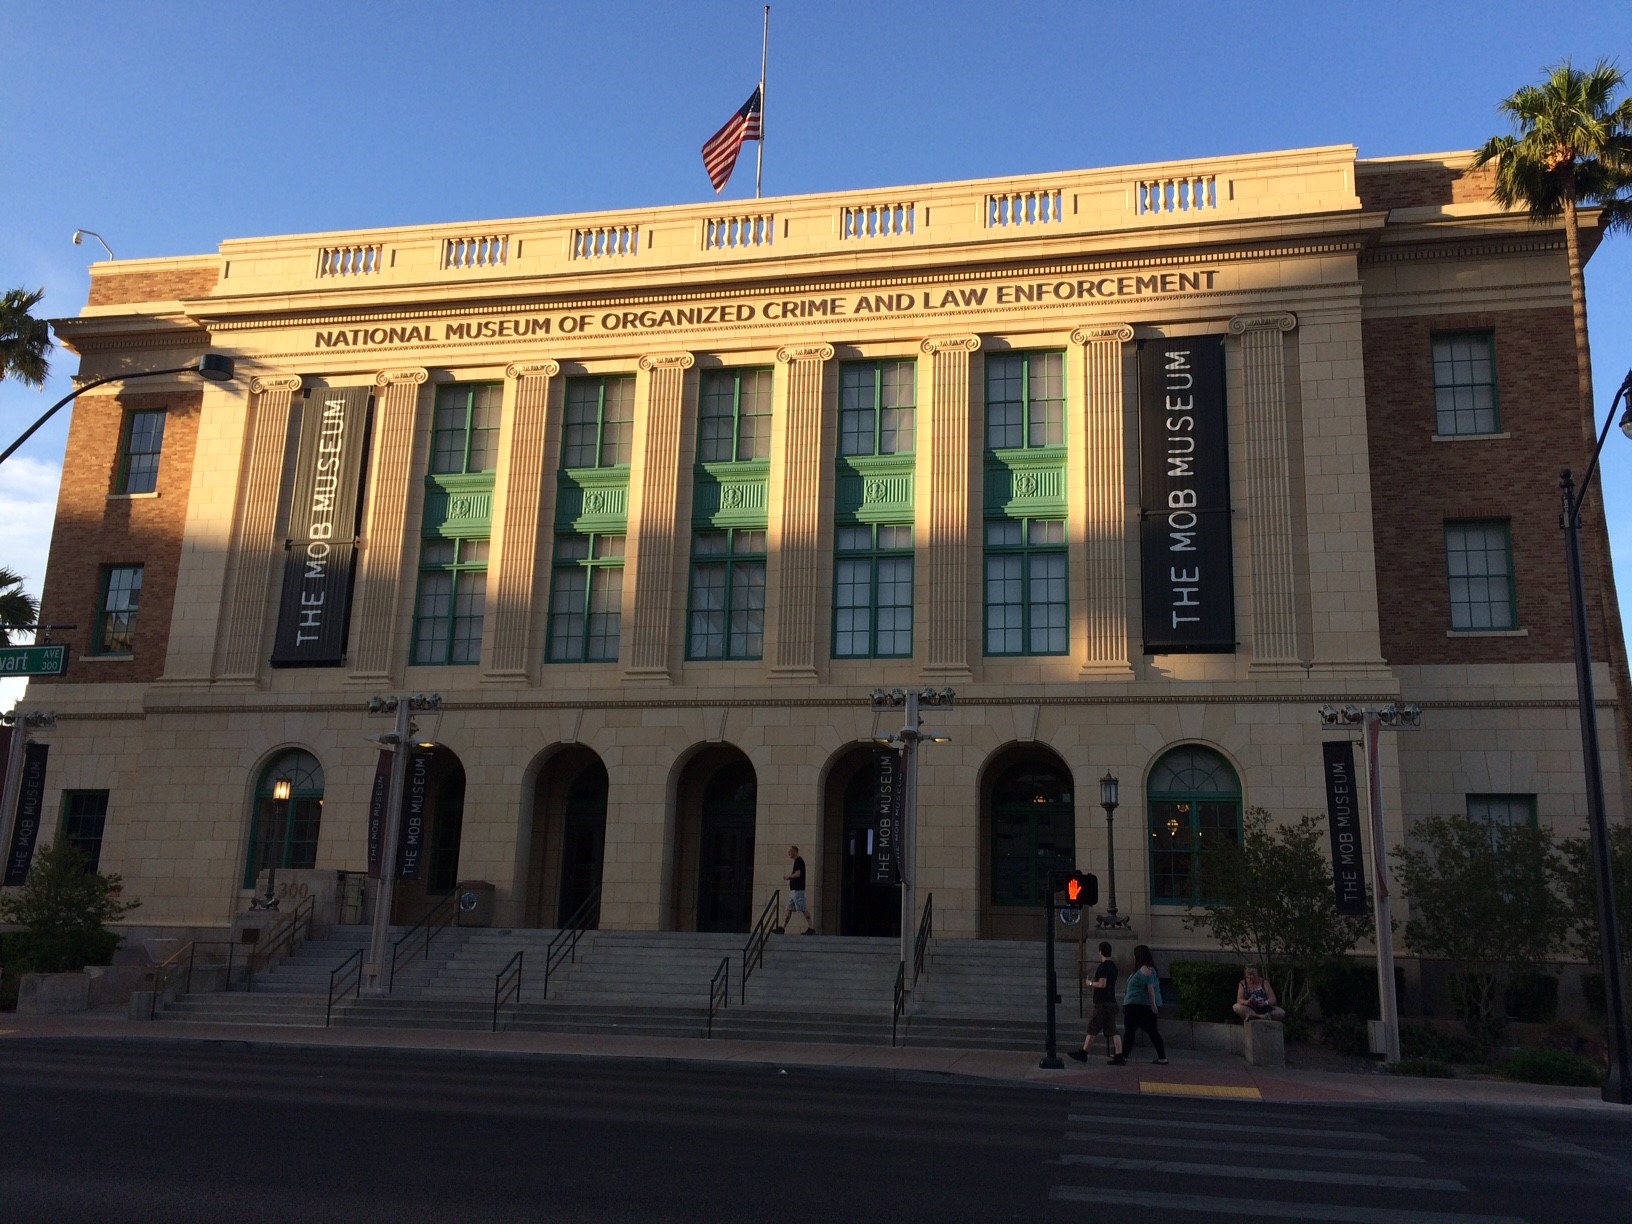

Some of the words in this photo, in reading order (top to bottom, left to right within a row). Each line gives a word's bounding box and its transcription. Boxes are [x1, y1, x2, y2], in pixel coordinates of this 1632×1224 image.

[315, 324, 438, 348] NATIONAL
[445, 317, 551, 341] MUSEUM
[558, 314, 595, 333] OF
[601, 304, 756, 331] ORGANIZED
[762, 298, 847, 321] CRIME
[853, 293, 916, 315] AND
[923, 287, 988, 310] LAW
[996, 270, 1220, 305] ENFORCEMENT
[1164, 350, 1195, 477] MUSEUM
[312, 399, 346, 512] MUSEUM
[1168, 488, 1198, 552] MOB
[304, 522, 333, 579] MOB
[1170, 566, 1200, 630] THE
[296, 591, 325, 647] THE
[41, 661, 58, 671] 300
[43, 649, 60, 659] AVE
[24, 761, 41, 815] MUSEUM
[373, 776, 385, 817] MUSEUM
[411, 758, 426, 813] MUSEUM
[880, 755, 892, 814] MUSEUM
[1332, 762, 1351, 827] MUSEUM
[18, 819, 34, 846] MOB
[371, 819, 380, 840] MOB
[407, 817, 421, 845] MOB
[879, 818, 891, 847] MOB
[12, 852, 28, 876] THE
[370, 843, 378, 861] THE
[402, 850, 418, 875] THE
[876, 853, 890, 880] THE
[1339, 832, 1354, 865] MOB
[1342, 871, 1358, 902] THE
